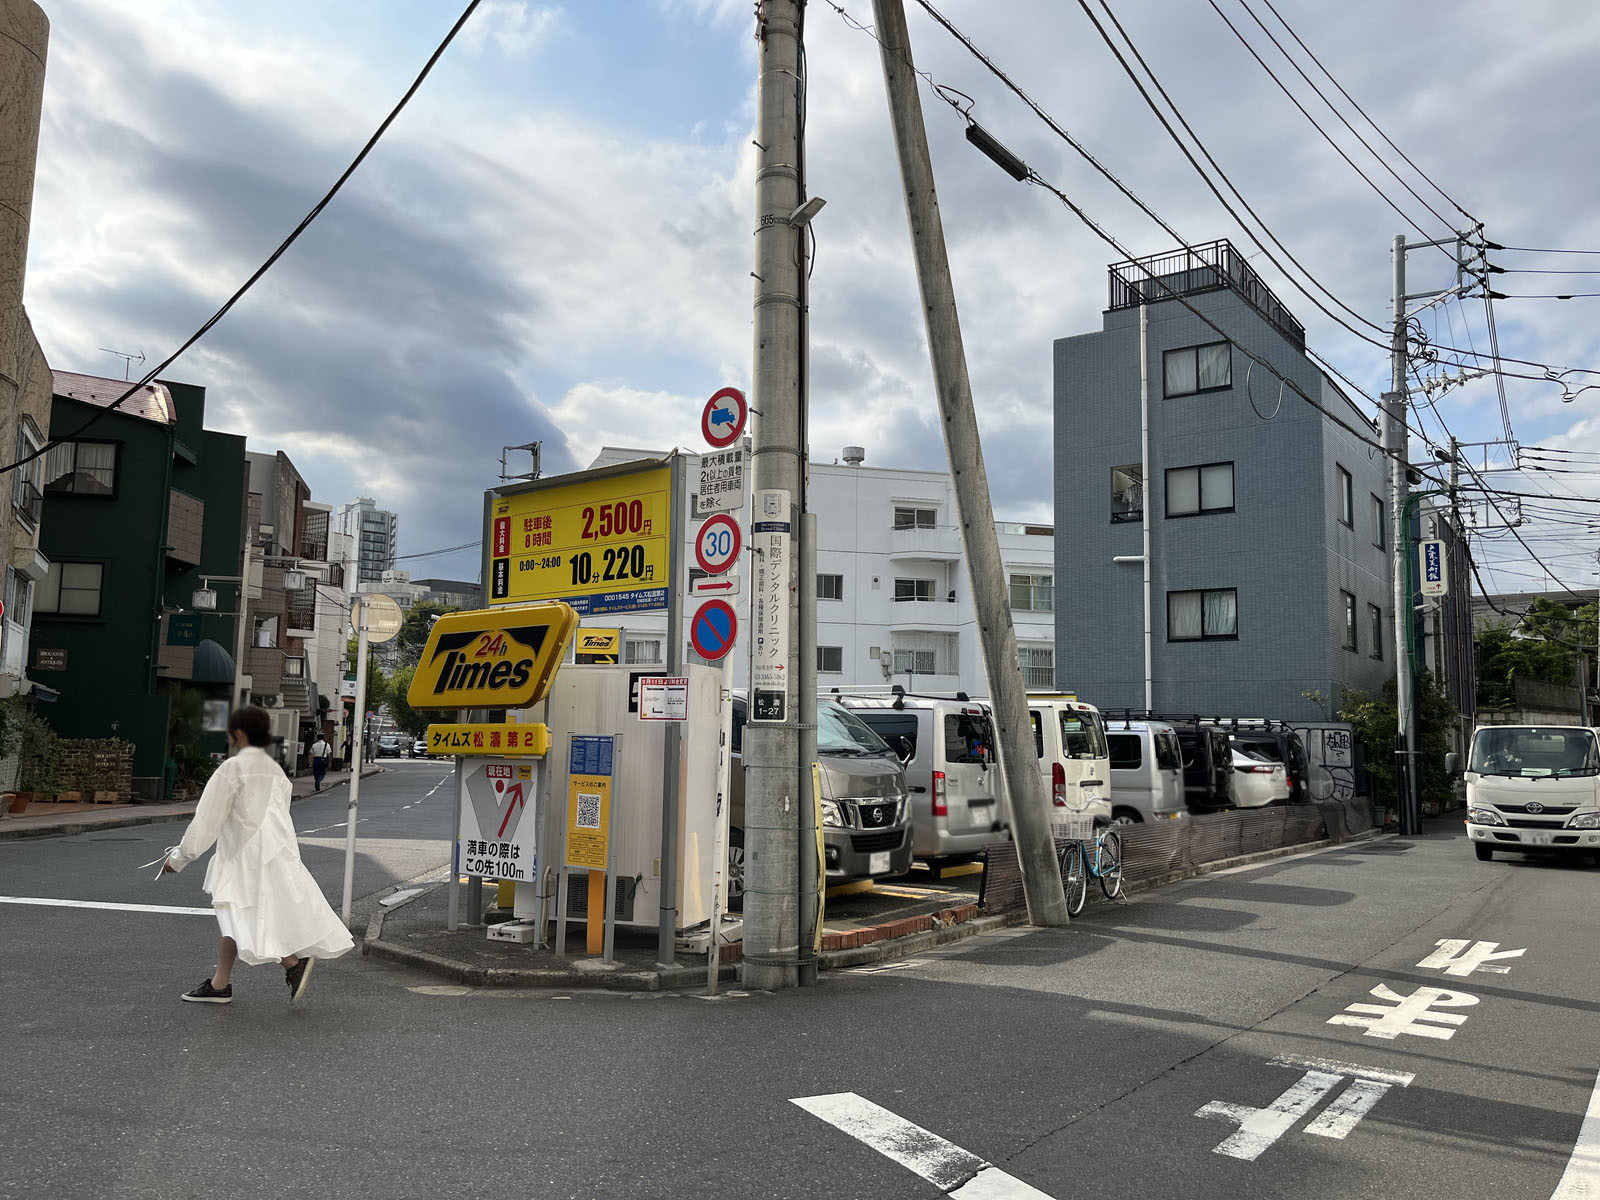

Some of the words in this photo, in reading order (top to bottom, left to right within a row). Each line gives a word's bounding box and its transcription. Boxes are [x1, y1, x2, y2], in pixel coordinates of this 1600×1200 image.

[701, 451, 742, 468] 最大積載量
[700, 466, 742, 482] 2t以上の貨物
[700, 480, 741, 496] 居住者用車両
[700, 496, 721, 509] を除く
[524, 515, 552, 531] 駐車後
[525, 531, 552, 548] 8時間
[705, 530, 731, 557] 30
[604, 593, 629, 602] 0001545
[769, 535, 782, 658] 国際デンタルクリニック
[474, 634, 508, 658] 24h
[431, 650, 534, 695] Times
[759, 707, 780, 715] 1-27
[487, 765, 510, 777] 現在地
[573, 781, 606, 789] サービスのご案内
[467, 840, 520, 859] 満車の際は
[465, 859, 524, 879] この先100m
